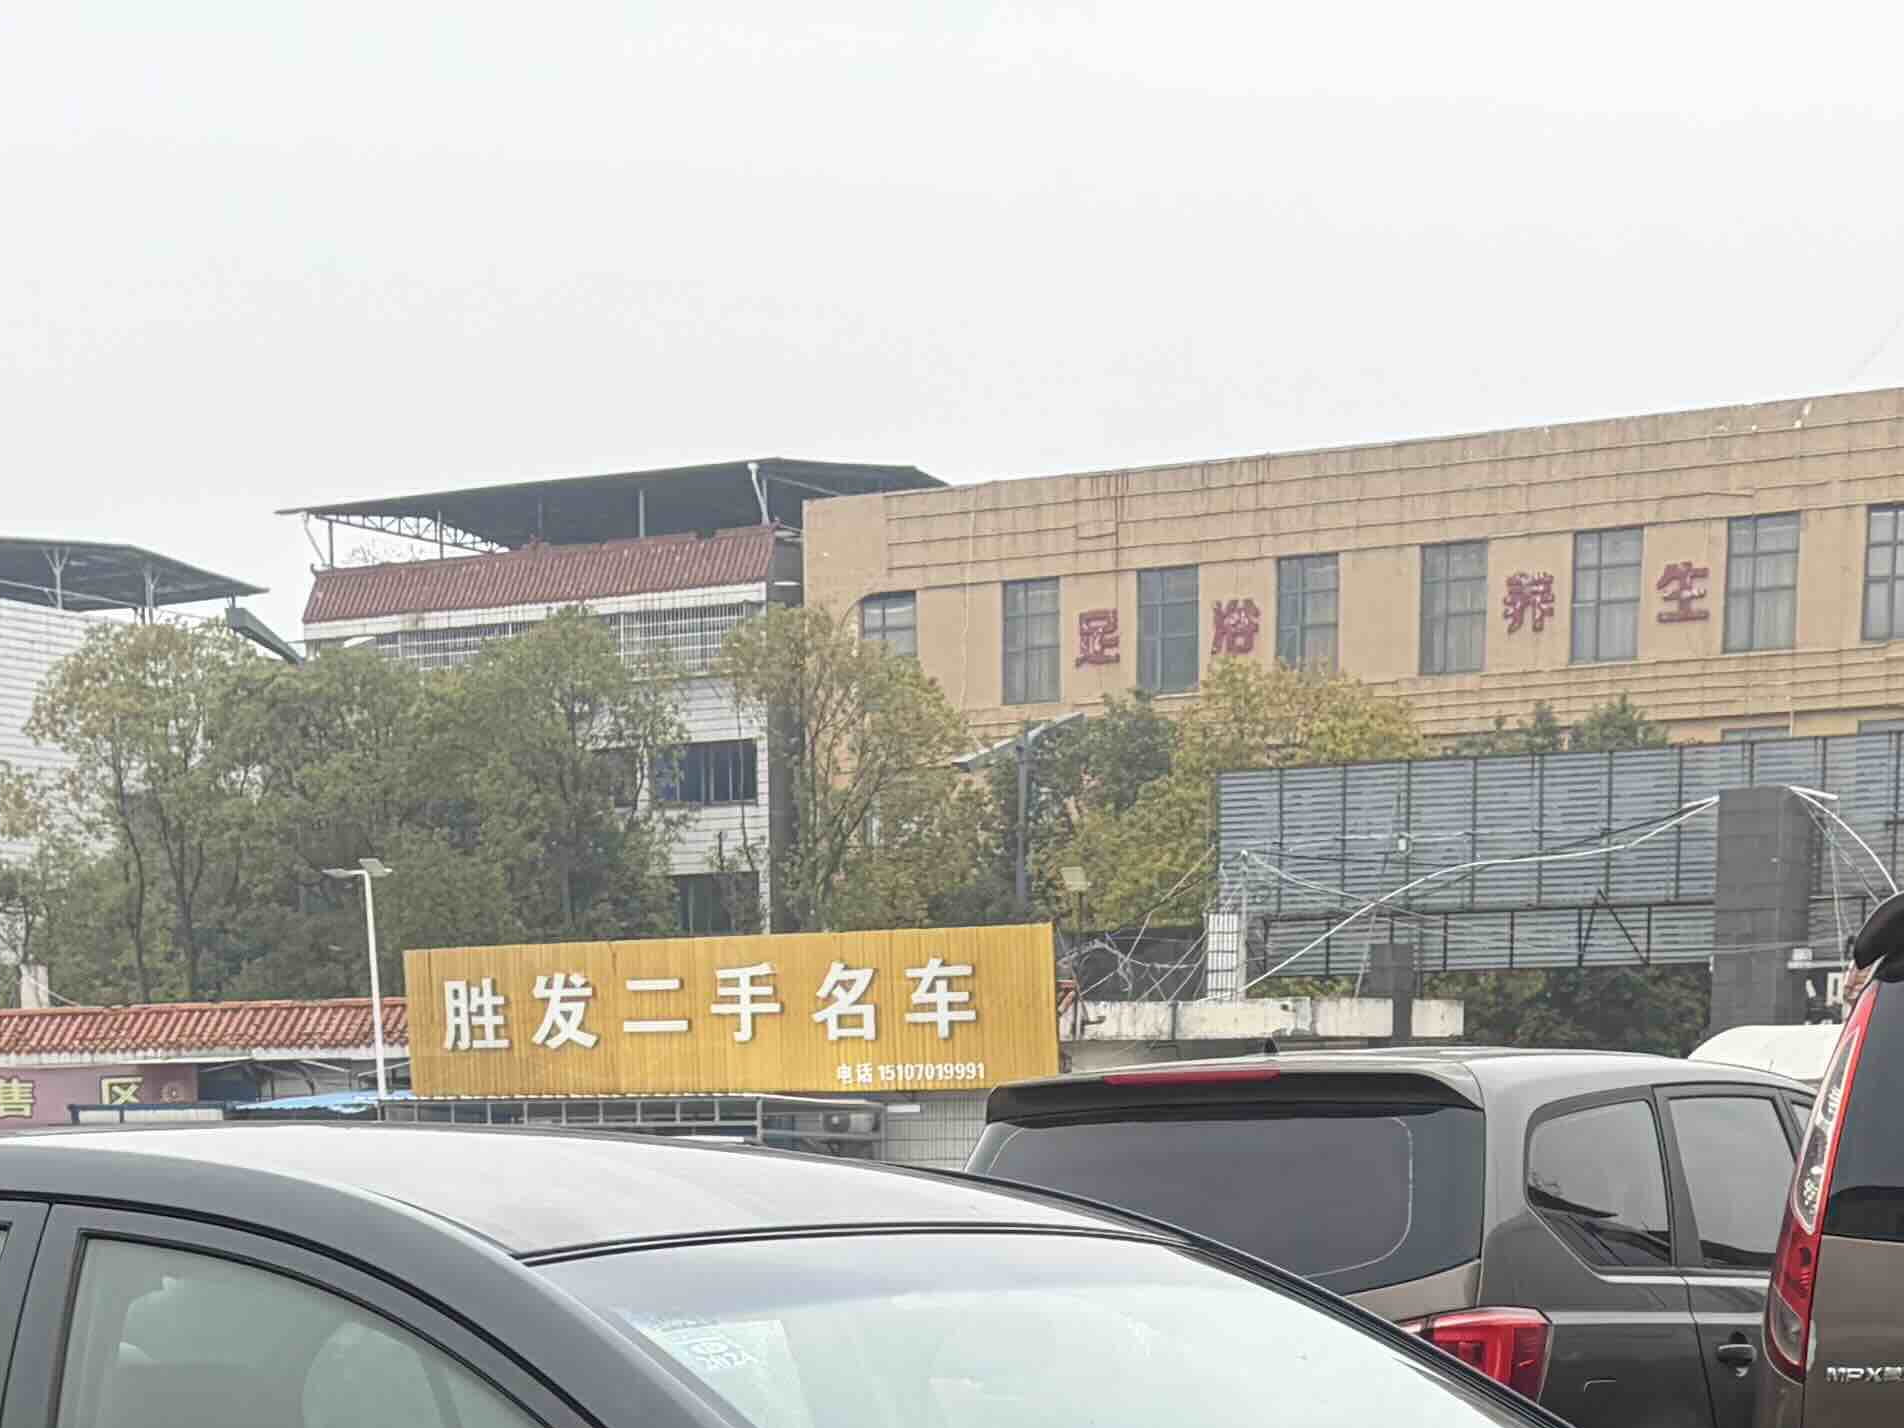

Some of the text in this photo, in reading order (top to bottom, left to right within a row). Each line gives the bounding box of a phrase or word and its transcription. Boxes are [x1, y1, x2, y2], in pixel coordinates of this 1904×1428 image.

[443, 956, 978, 1051] 胜发二手名车
[837, 1062, 985, 1085] 电话 15107019991
